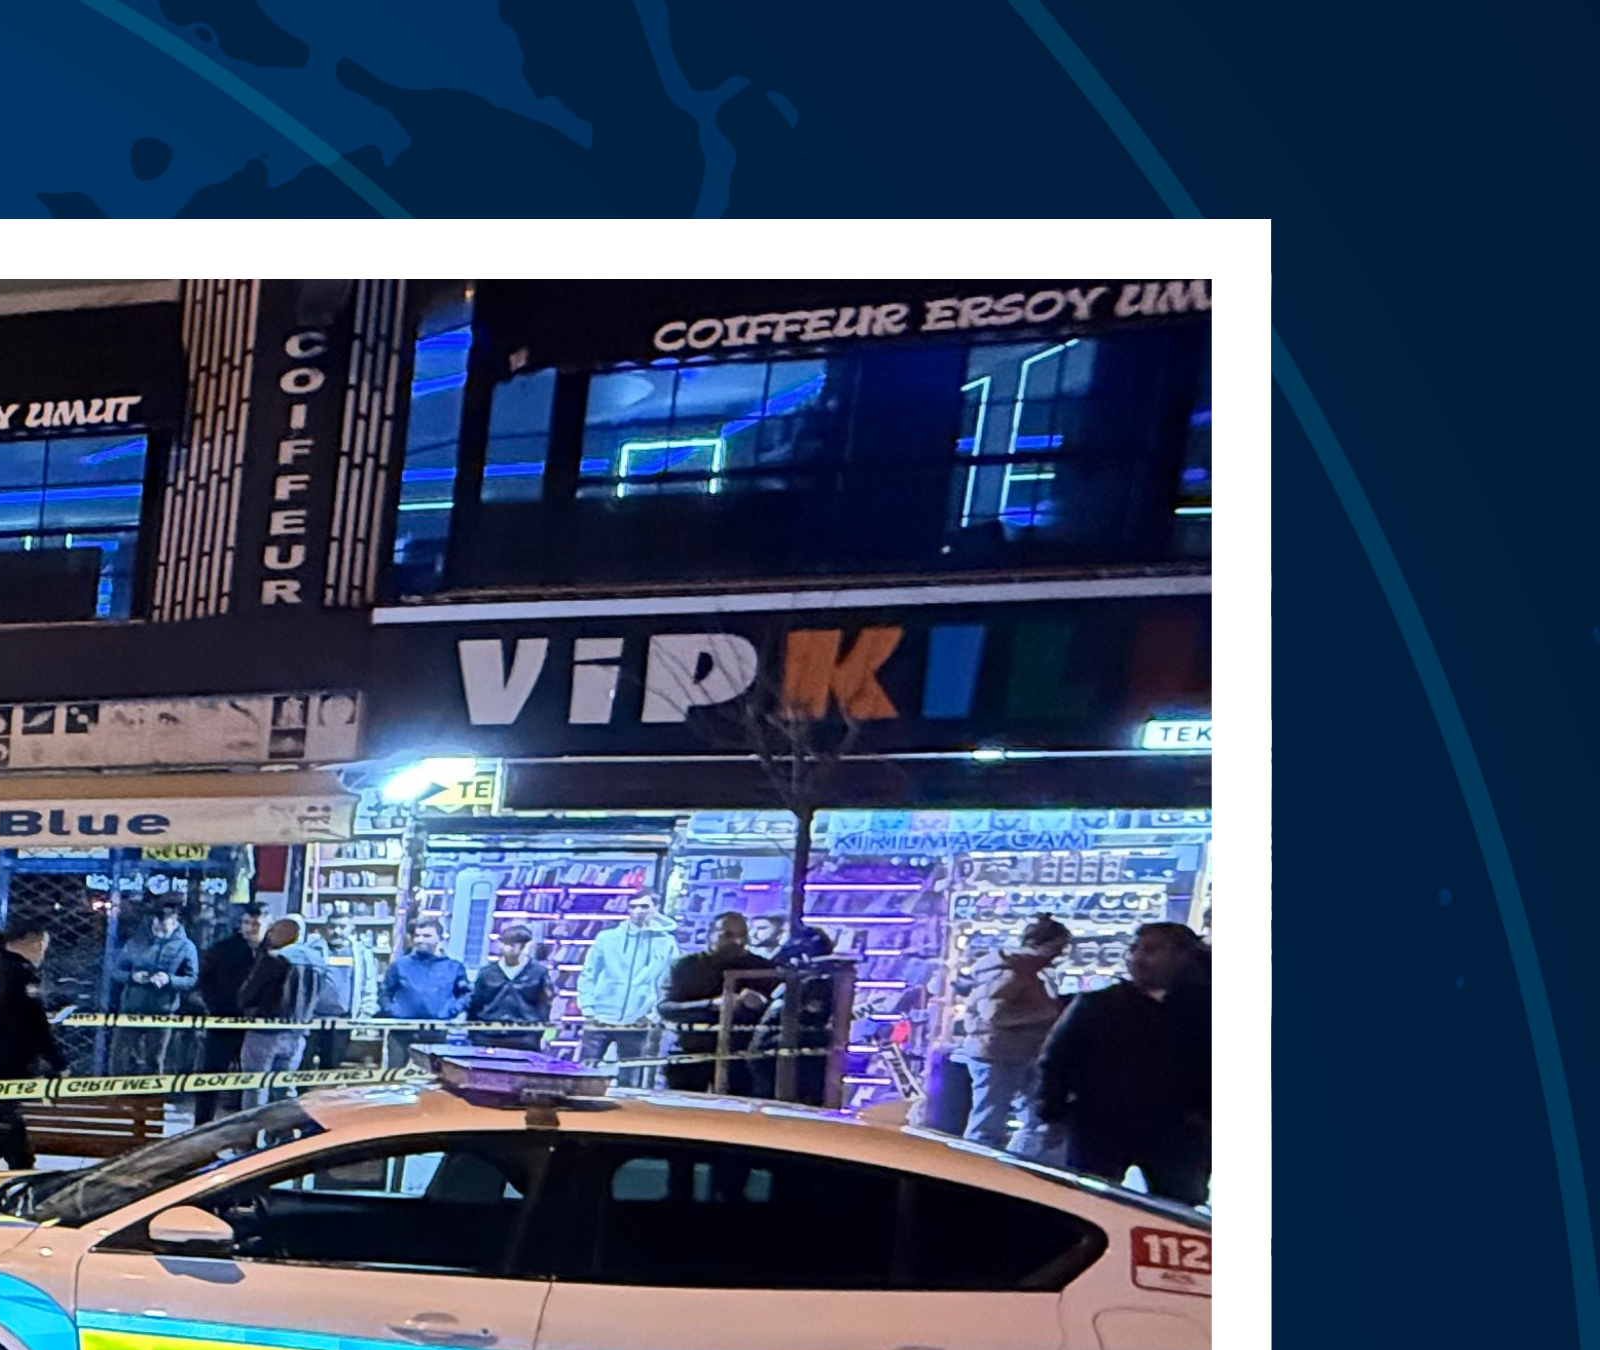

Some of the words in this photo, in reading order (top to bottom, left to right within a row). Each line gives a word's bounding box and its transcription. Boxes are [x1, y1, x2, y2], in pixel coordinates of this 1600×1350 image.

[653, 303, 908, 352] COIFFEUR
[920, 285, 1107, 332] ERSOY
[23, 396, 142, 428] UMUT
[261, 331, 327, 606] COIFFEUR
[1160, 726, 1212, 742] TEK
[834, 829, 991, 851] KIRILMAZ
[1007, 830, 1091, 850] CAM
[1143, 1233, 1211, 1271] 112
